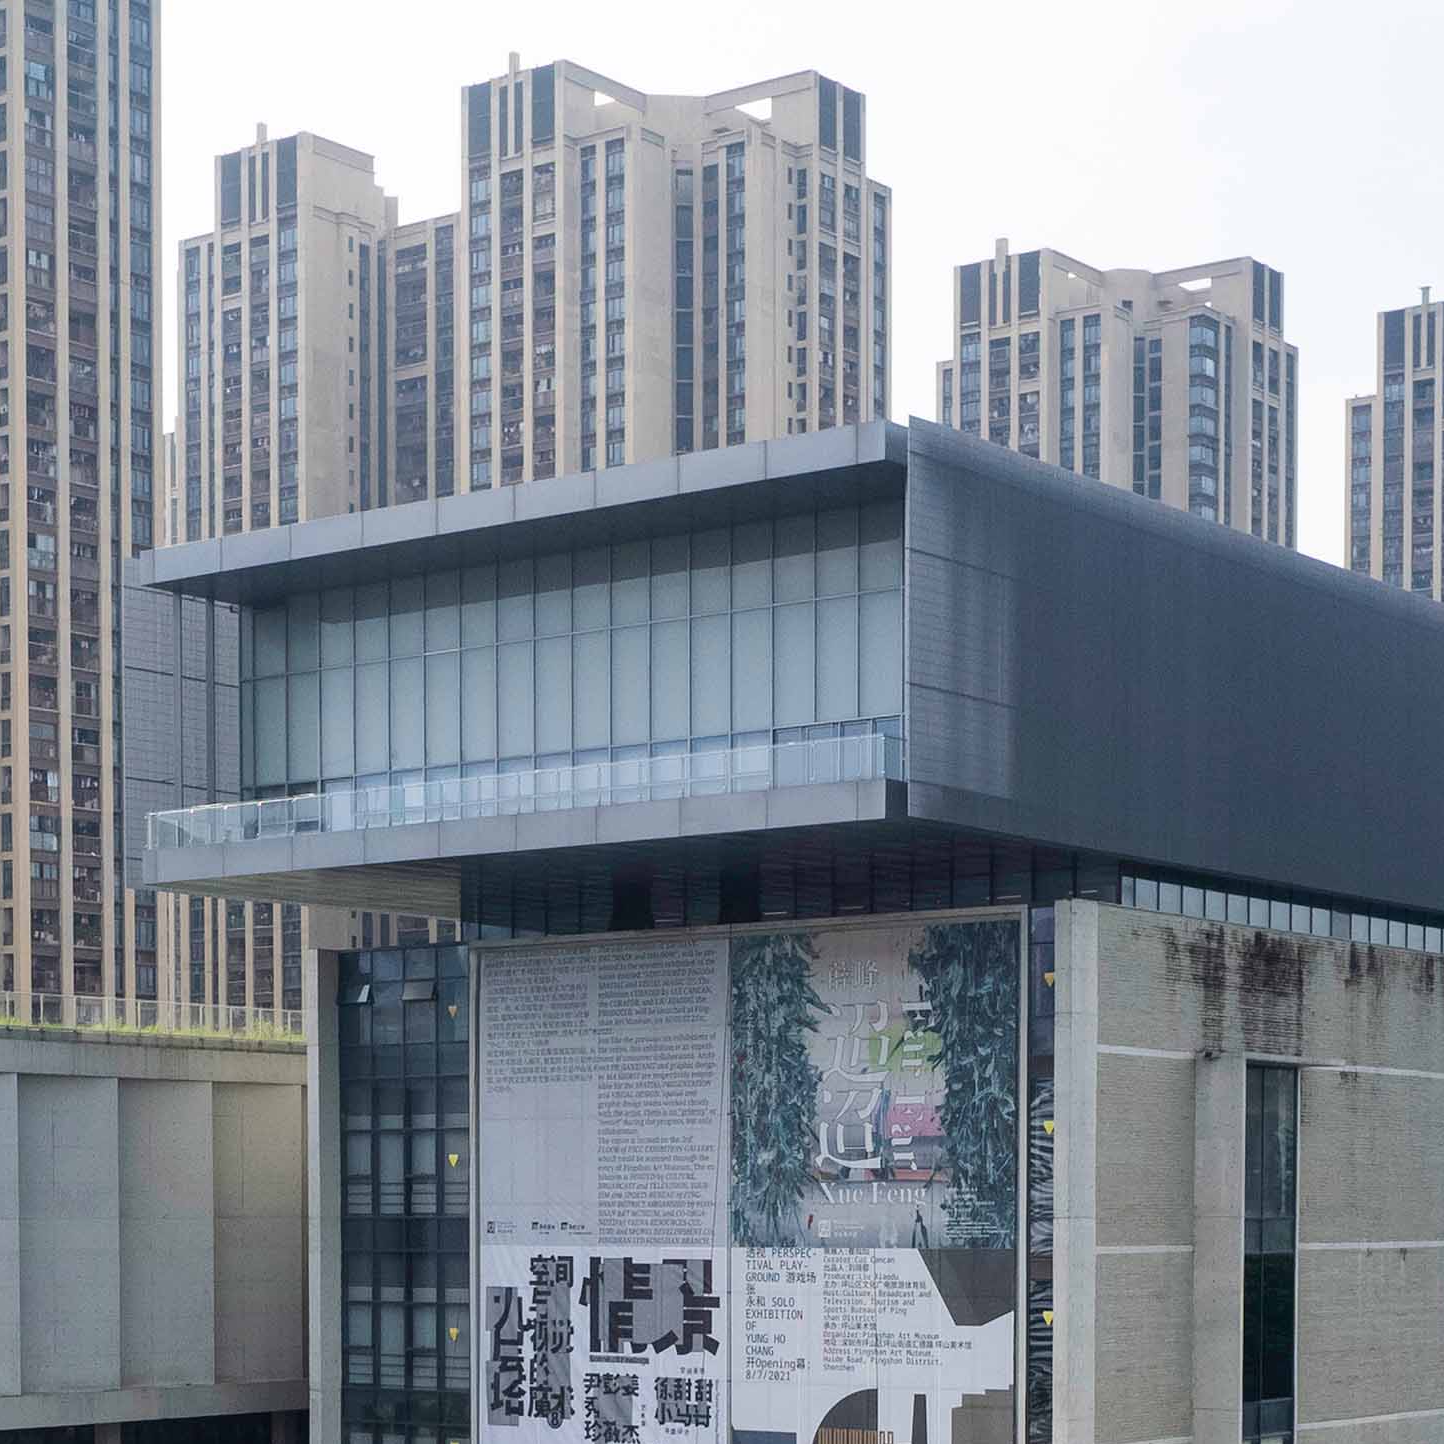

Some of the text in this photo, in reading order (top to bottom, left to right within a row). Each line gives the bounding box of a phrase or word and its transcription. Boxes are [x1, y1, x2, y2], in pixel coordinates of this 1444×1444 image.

[820, 1182, 927, 1206] Xue Feng
[771, 1248, 817, 1258] PERSPEC-
[746, 1261, 808, 1271] TIVAL PLAY-
[745, 1273, 780, 1282] GROUND
[771, 1297, 795, 1307] SOLO
[745, 1309, 803, 1320] EXHIBITION
[745, 1322, 756, 1331] OF
[745, 1334, 786, 1344] YUNG HO
[745, 1346, 774, 1356] CHANG
